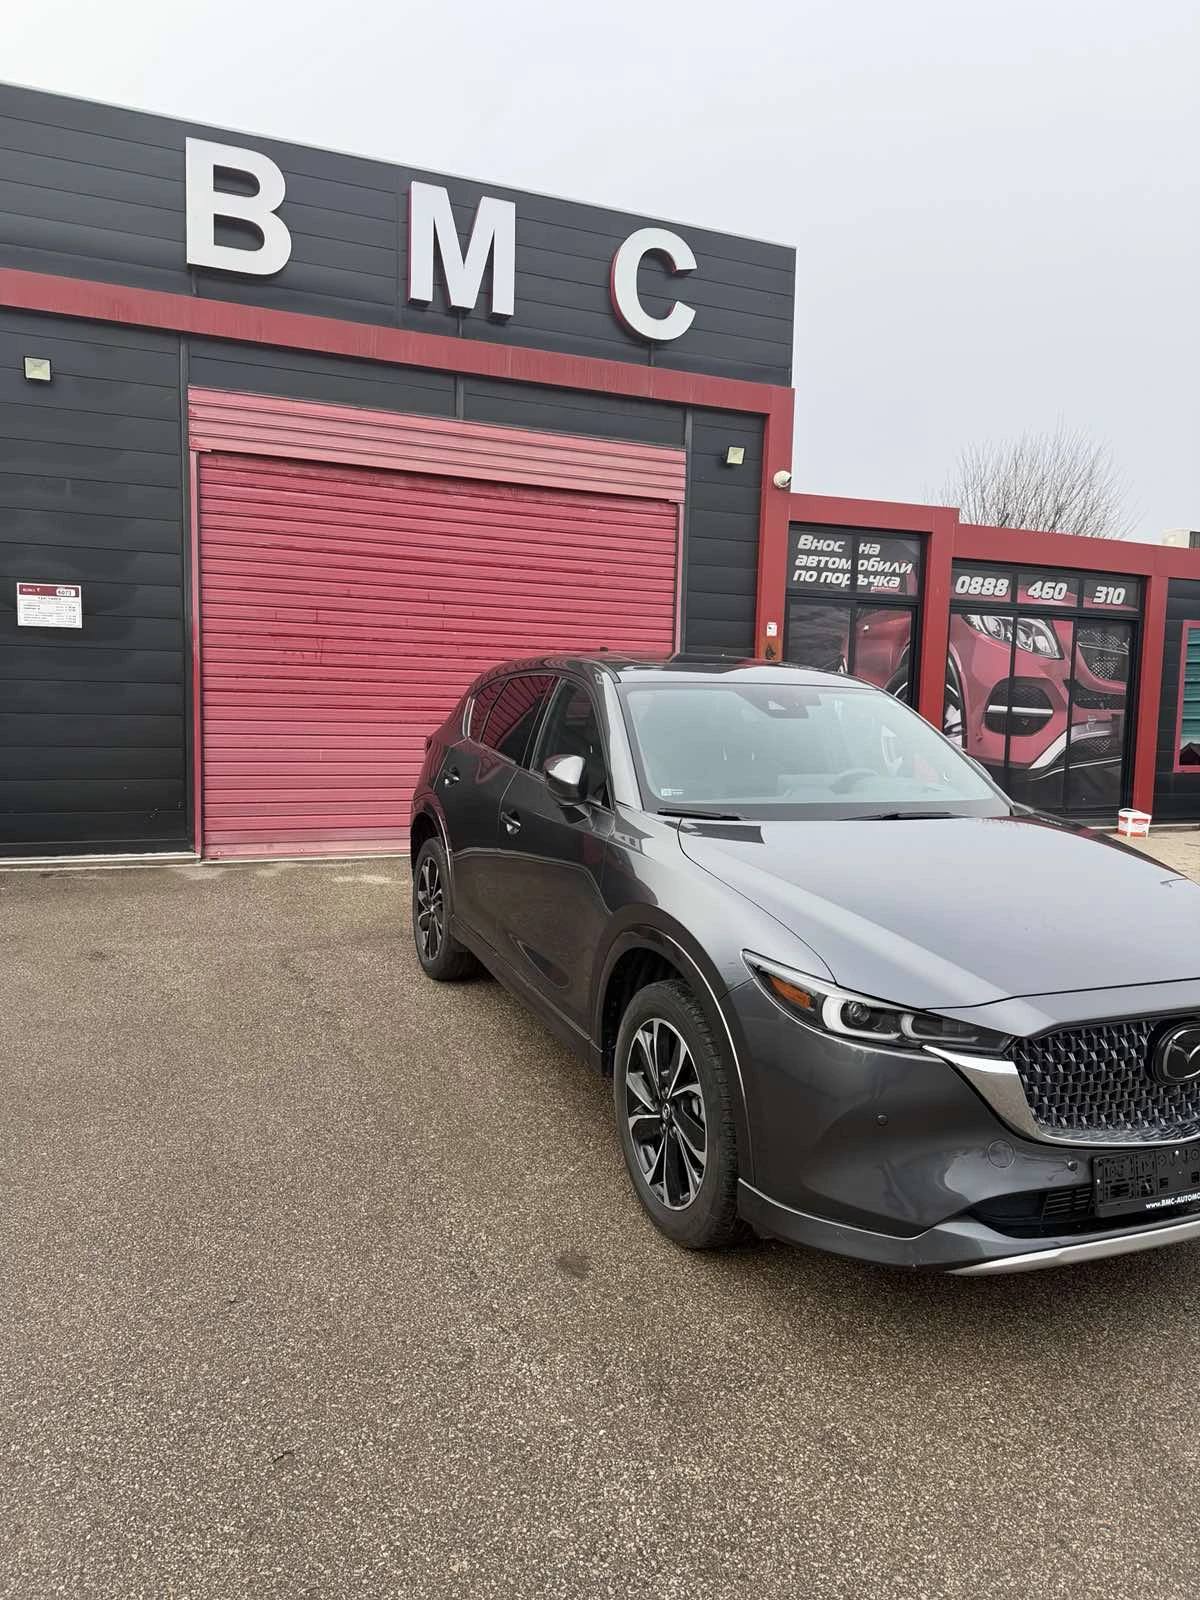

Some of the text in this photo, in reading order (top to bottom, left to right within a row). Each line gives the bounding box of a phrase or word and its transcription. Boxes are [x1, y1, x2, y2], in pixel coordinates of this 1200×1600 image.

[797, 534, 881, 555] Внос на
[792, 569, 818, 582] по
[955, 575, 1126, 605] 0888 460 310
